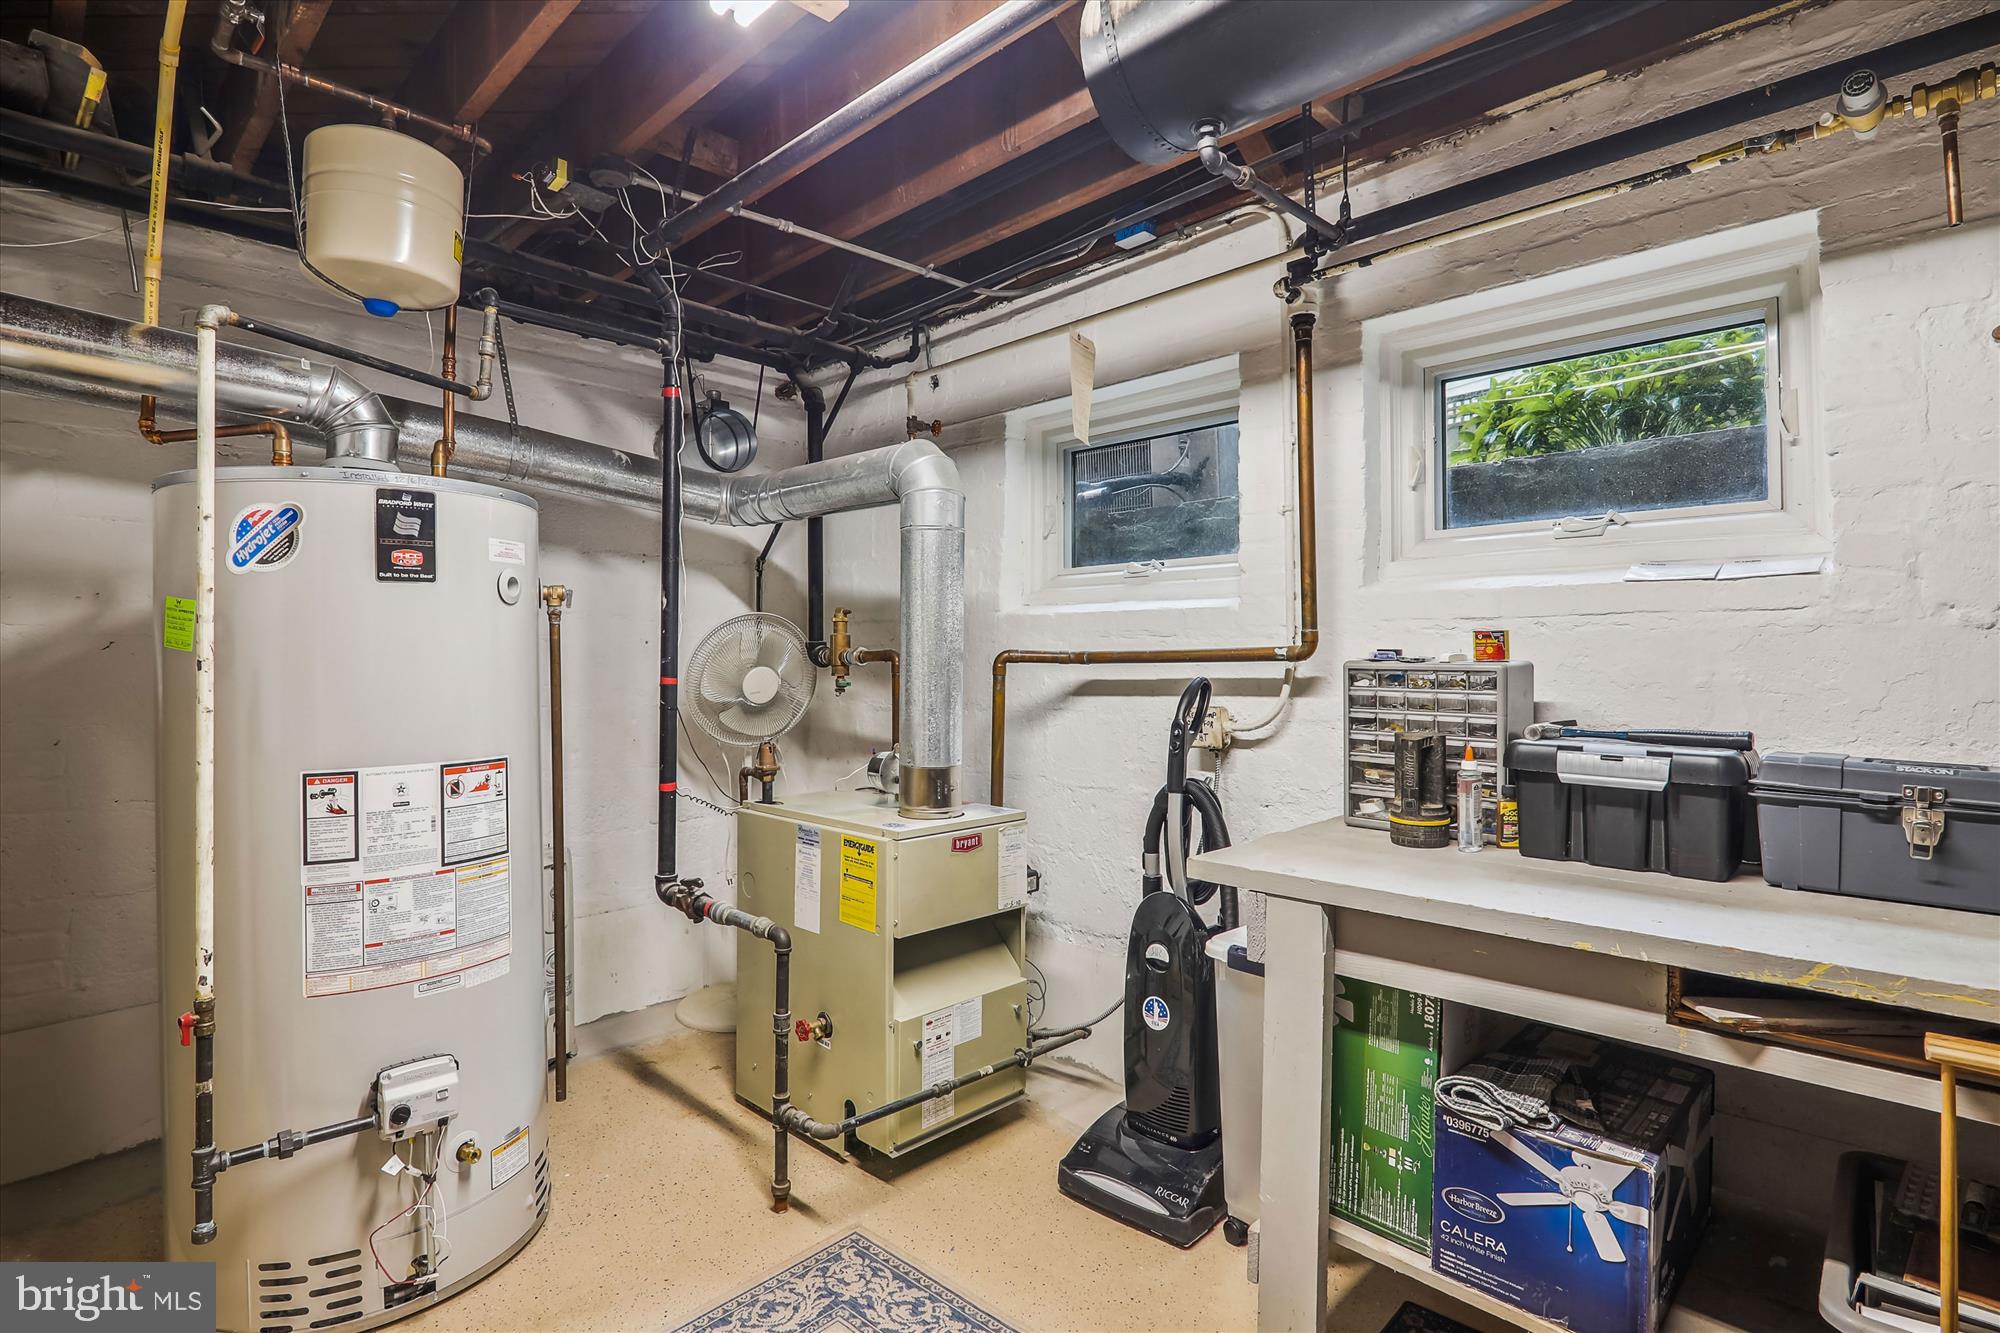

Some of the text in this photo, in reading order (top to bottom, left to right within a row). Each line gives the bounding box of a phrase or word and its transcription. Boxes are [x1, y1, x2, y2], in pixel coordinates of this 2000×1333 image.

[378, 498, 412, 506] BRADFORD
[236, 523, 276, 563] Hydrojet
[956, 836, 979, 849] bryant
[1411, 1094, 1433, 1158] Hunter
[1155, 1186, 1190, 1209] RICCAR
[1449, 1193, 1498, 1219] Harbor Breeze
[1440, 1220, 1507, 1255] CALERA
[1440, 1233, 1449, 1242] 42
[1466, 1242, 1485, 1256] White
[1486, 1250, 1506, 1263] Finish
